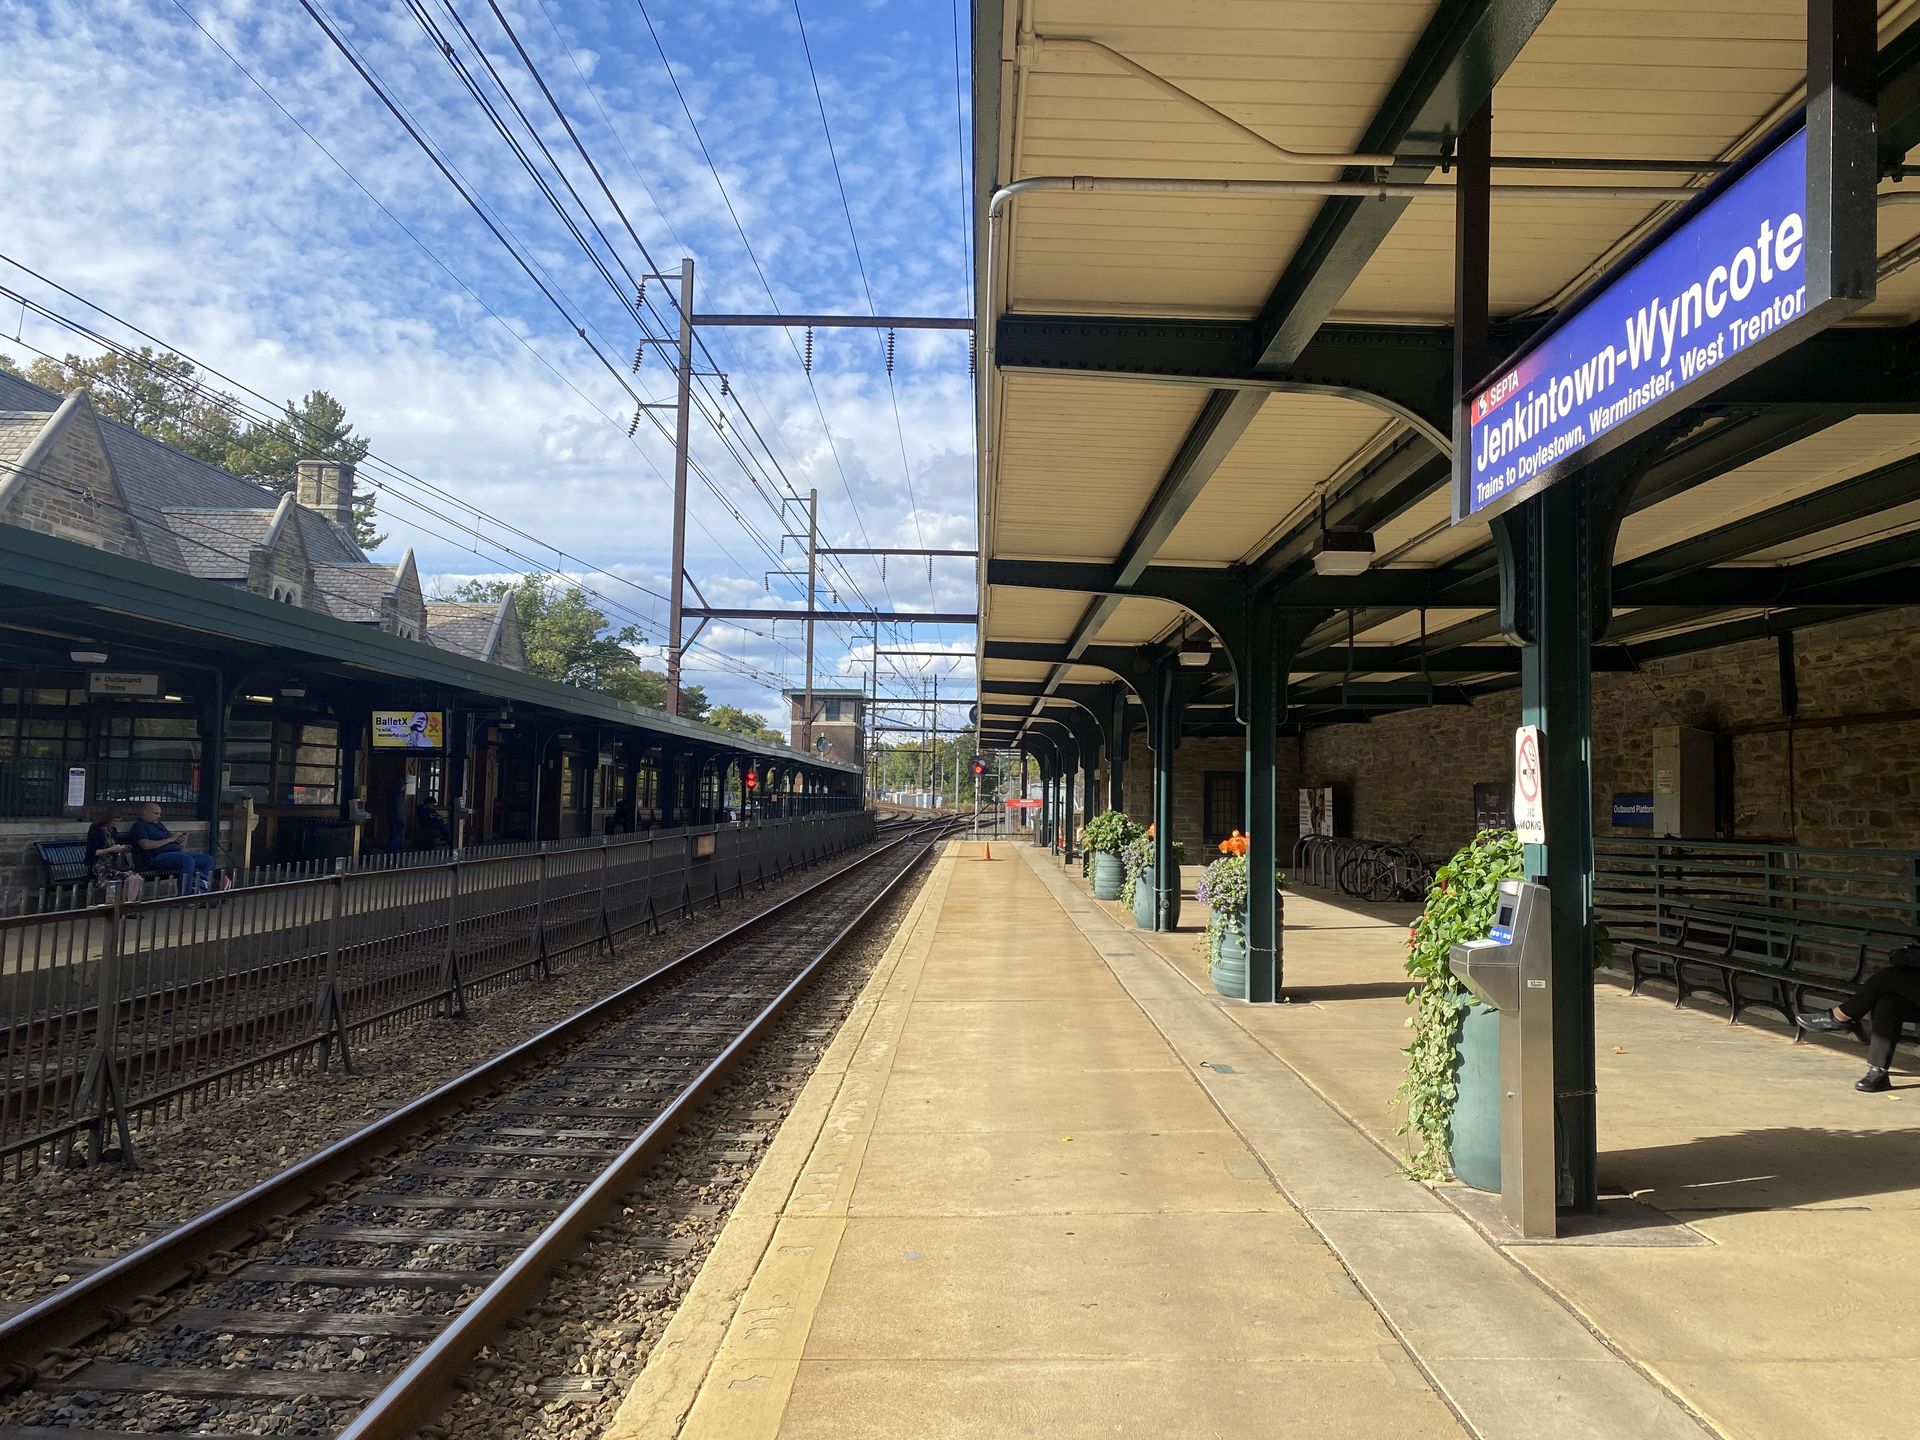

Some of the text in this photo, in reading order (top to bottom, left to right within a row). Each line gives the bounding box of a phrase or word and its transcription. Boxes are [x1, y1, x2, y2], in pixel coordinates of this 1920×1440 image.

[1477, 212, 1803, 472] Jenkintown-Wyncote
[1490, 369, 1519, 406] SEPTA
[1477, 474, 1504, 503] Trains
[1506, 466, 1516, 486] to
[1518, 425, 1585, 479] Doylestown,
[1589, 368, 1674, 435] Warminster,
[1680, 332, 1724, 381] West
[104, 675, 142, 683] Outbound
[375, 717, 408, 726] BalletX
[1527, 808, 1536, 818] NO
[1613, 804, 1636, 813] Outbound
